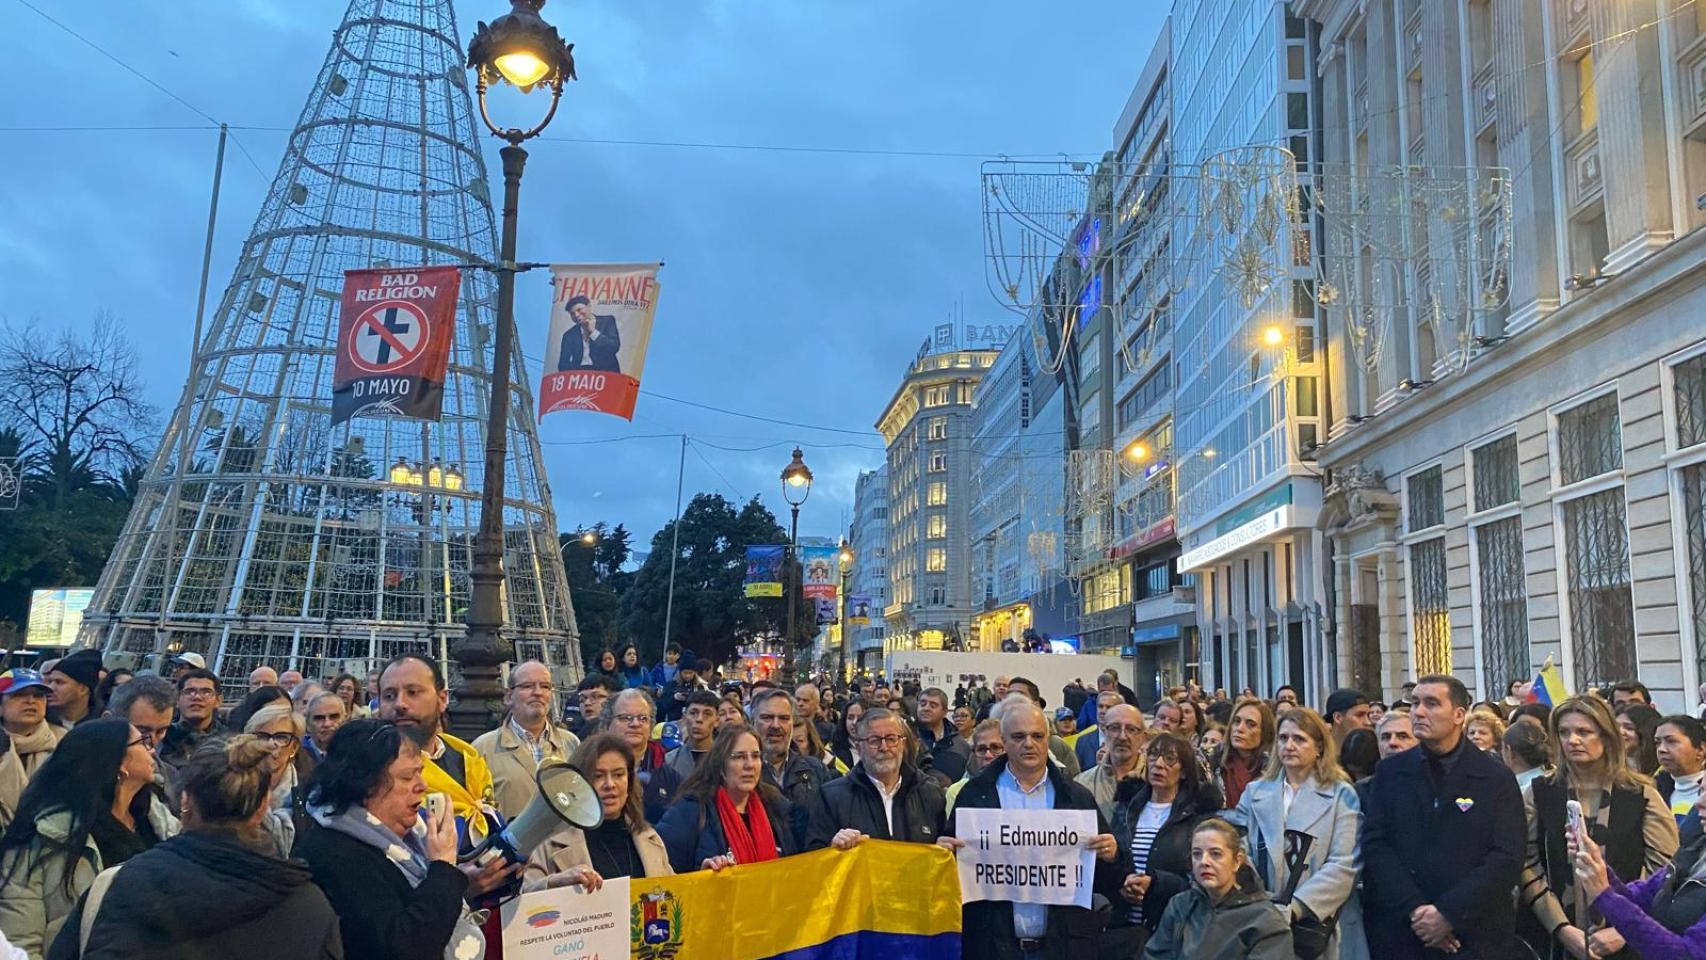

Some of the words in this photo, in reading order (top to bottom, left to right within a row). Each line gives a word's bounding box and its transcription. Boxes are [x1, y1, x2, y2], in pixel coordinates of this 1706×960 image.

[380, 273, 418, 287] BAD
[355, 286, 437, 301] RELIGION
[352, 381, 364, 399] 10
[368, 378, 410, 396] MAYO
[551, 375, 565, 392] 18
[567, 374, 606, 391] MAIO
[980, 830, 989, 850] ¡¡
[1000, 825, 1078, 846] Edmundo
[976, 863, 1066, 887] PRESIDENTE
[1075, 865, 1083, 887] !!
[589, 912, 613, 920] MADURO
[519, 936, 544, 946] RESPETE
[553, 928, 582, 939] VOLUNTAD
[582, 926, 593, 934] DEL
[594, 922, 615, 931] PUEBLO
